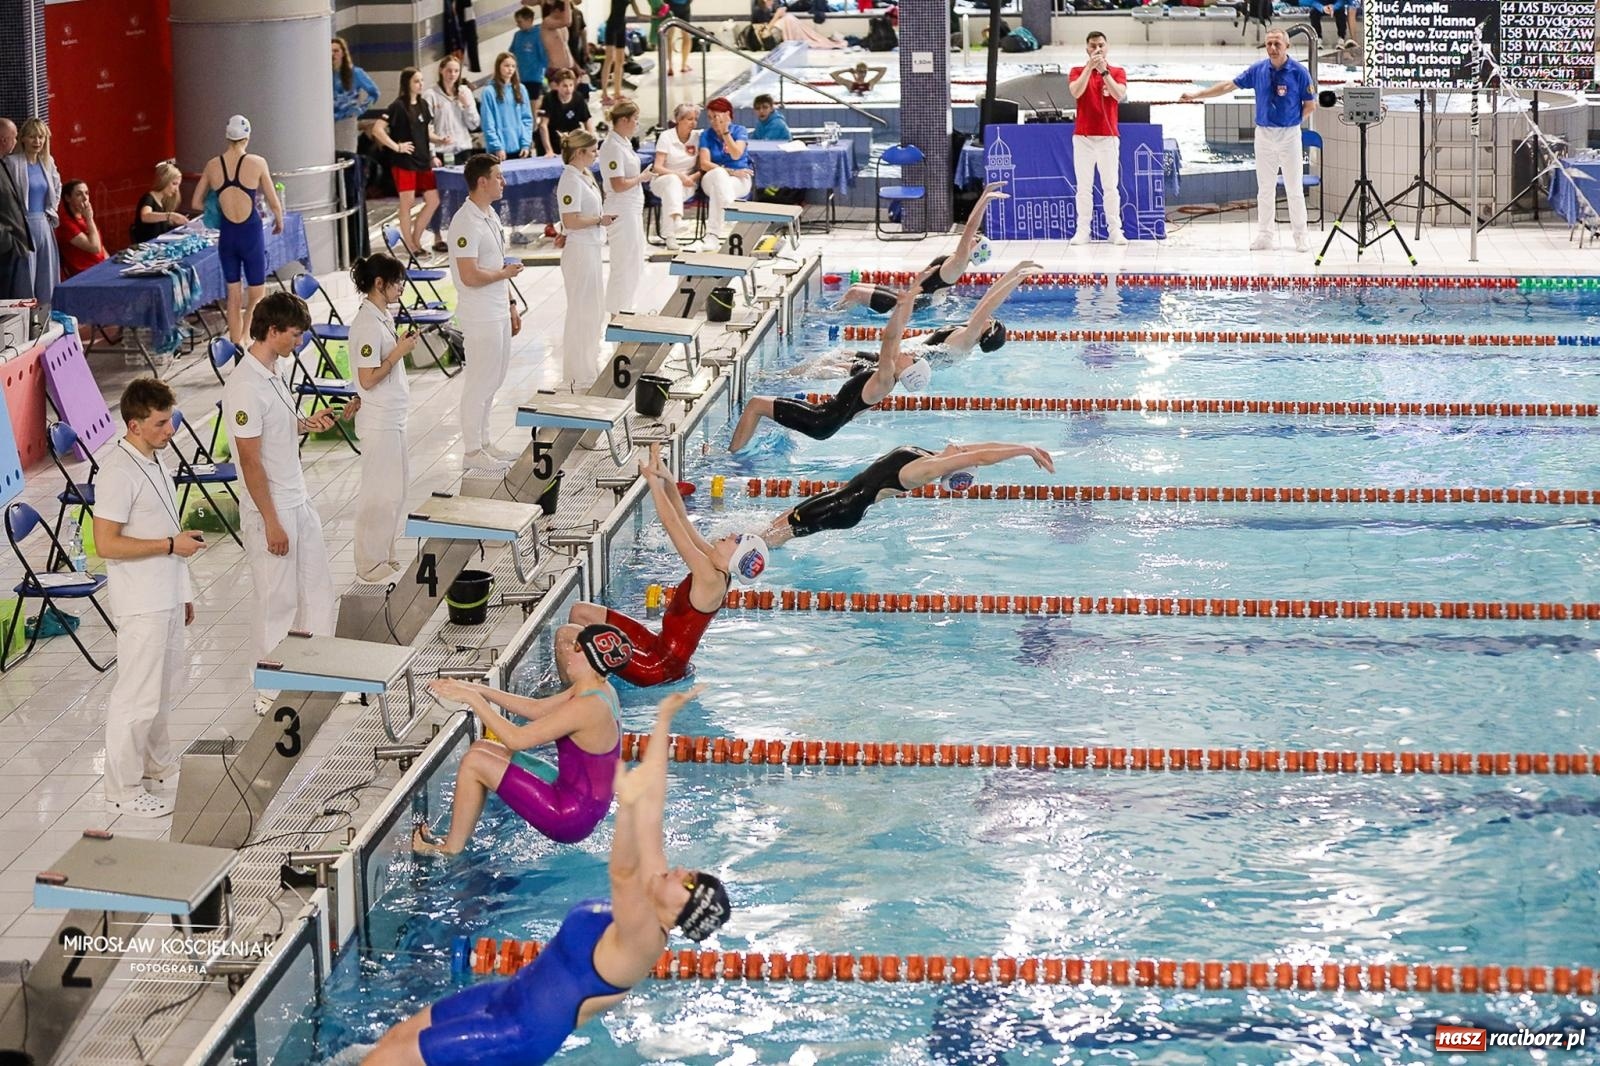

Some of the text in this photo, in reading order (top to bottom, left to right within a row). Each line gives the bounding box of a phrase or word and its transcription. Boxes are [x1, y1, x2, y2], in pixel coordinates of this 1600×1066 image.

[1433, 15, 1476, 26] Hanna
[1500, 15, 1534, 26] SP-63
[1501, 2, 1515, 13] 44
[1519, 2, 1540, 13] MS
[1542, 2, 1595, 16] Bydgosz
[1375, 41, 1447, 52] Godlewska
[1502, 41, 1523, 52] 158
[1525, 41, 1595, 52] WARSZAW
[1502, 28, 1523, 39] 158
[1525, 28, 1595, 39] WARSZAW
[1375, 53, 1405, 64] Ciba
[1408, 53, 1461, 64] Barbara
[1500, 53, 1521, 64] SSP
[1375, 66, 1416, 78] Hipner
[1420, 66, 1450, 77] Lena
[729, 233, 743, 256] 8
[680, 287, 696, 318] 7
[613, 354, 631, 389] 6
[533, 441, 553, 480] 5
[416, 553, 438, 597] 4
[593, 631, 632, 668] 63
[274, 705, 301, 758] 3
[59, 926, 93, 988] 2
